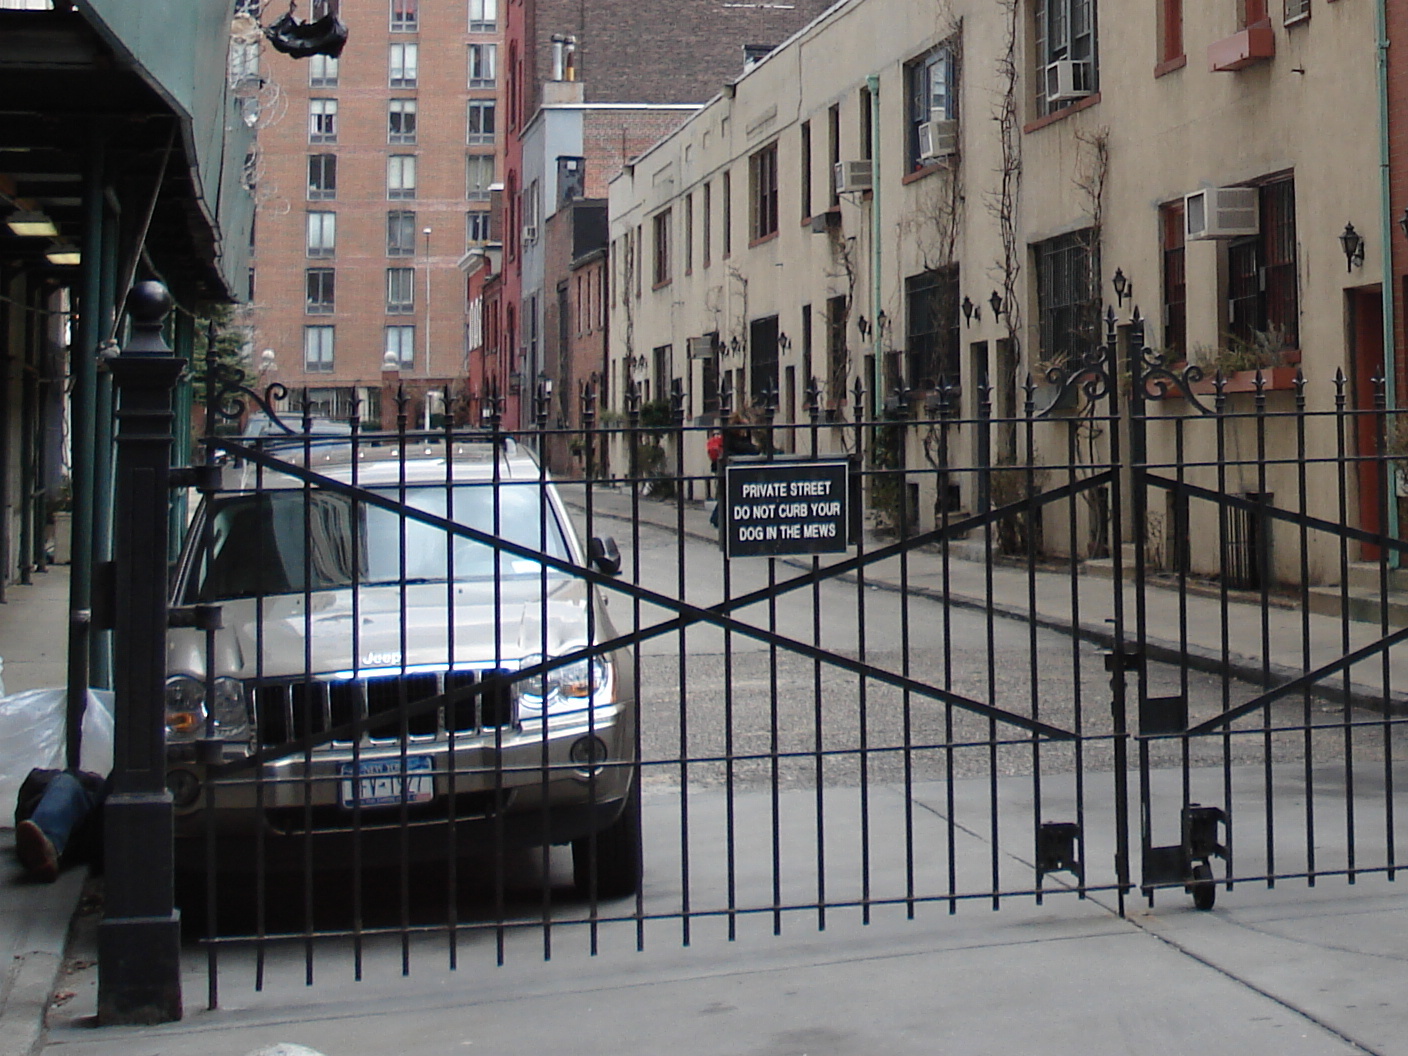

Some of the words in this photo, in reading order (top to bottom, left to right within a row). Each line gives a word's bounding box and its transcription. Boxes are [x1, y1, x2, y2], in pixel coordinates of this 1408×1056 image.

[742, 483, 787, 498] PRIVATE
[790, 481, 831, 496] STREET
[734, 505, 750, 520] DO
[752, 504, 776, 519] NOT
[778, 503, 808, 518] CURB
[811, 502, 841, 517] YOUR
[739, 526, 764, 541] DOG
[766, 526, 777, 540] IN
[779, 525, 801, 539] THE
[803, 523, 836, 538] MEWS
[362, 652, 402, 665] Jeep
